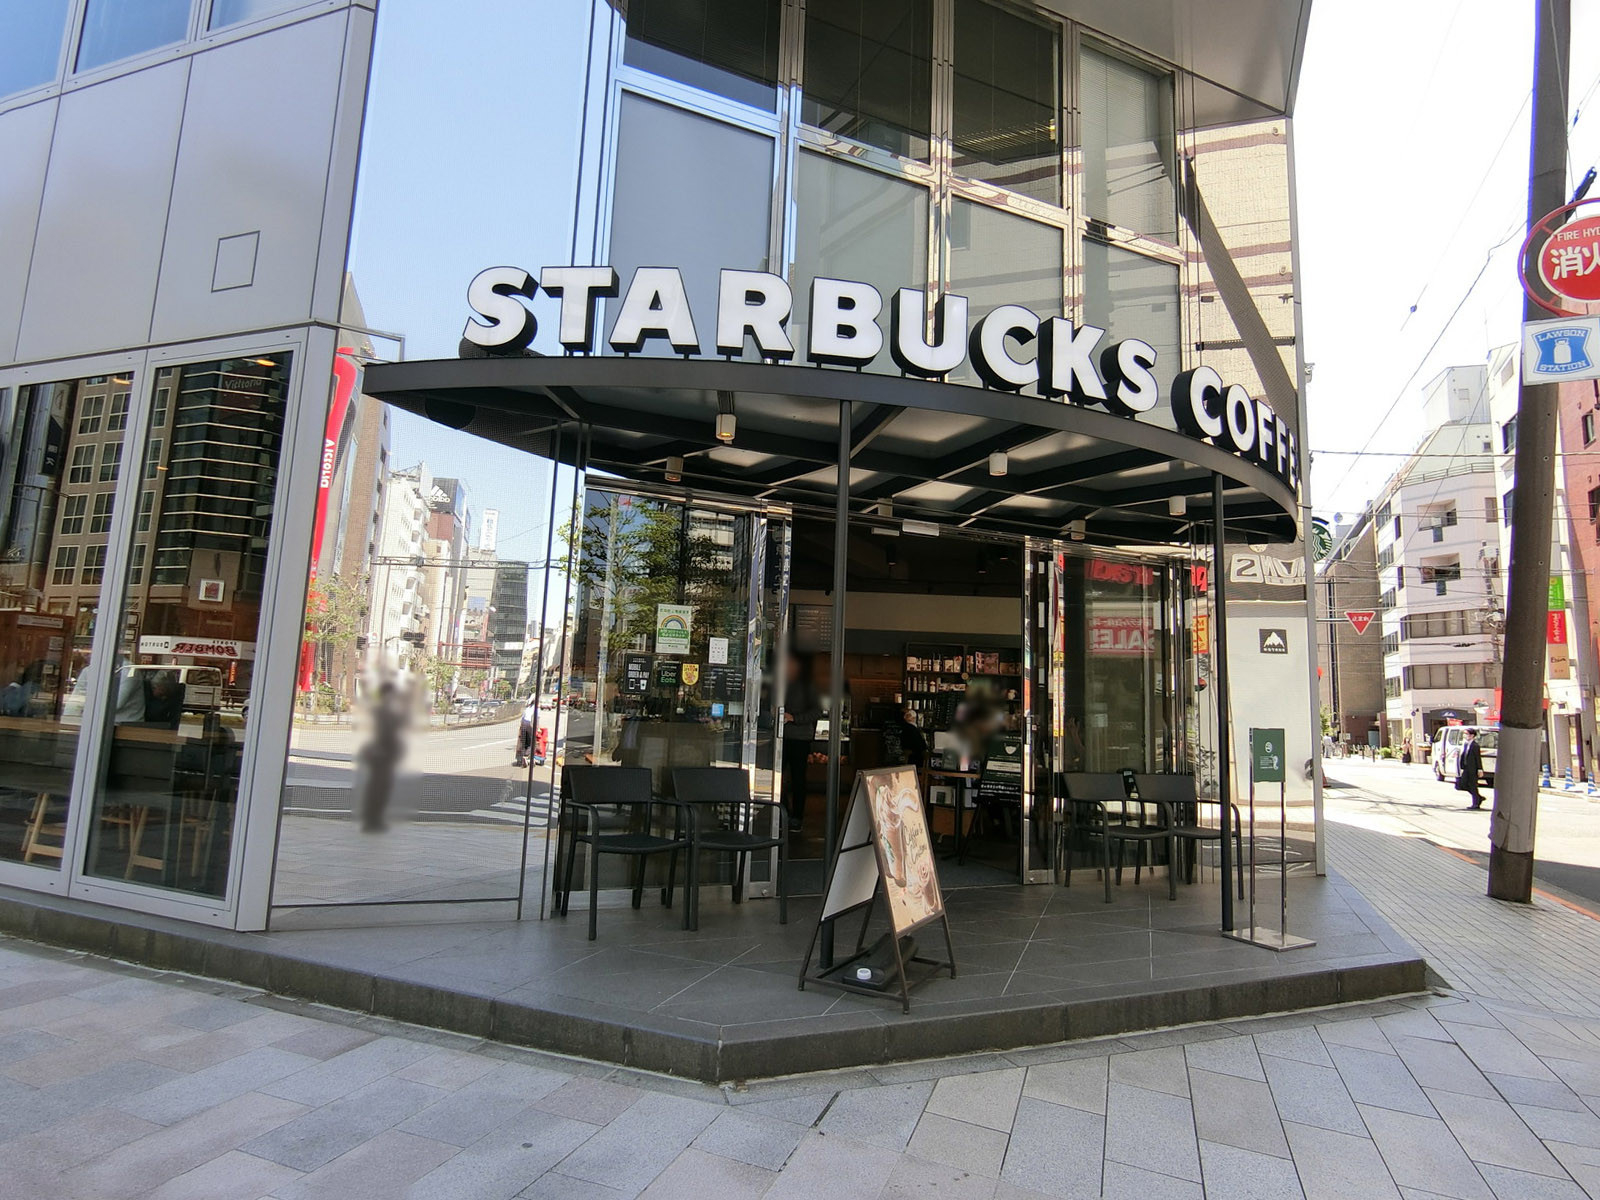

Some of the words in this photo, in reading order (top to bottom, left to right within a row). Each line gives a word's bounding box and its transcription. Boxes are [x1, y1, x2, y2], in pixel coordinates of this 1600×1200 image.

[1557, 230, 1580, 242] FIRE
[462, 266, 1158, 412] STARBUCKS
[1537, 330, 1587, 341] LAWSON
[1540, 361, 1586, 371] STATION
